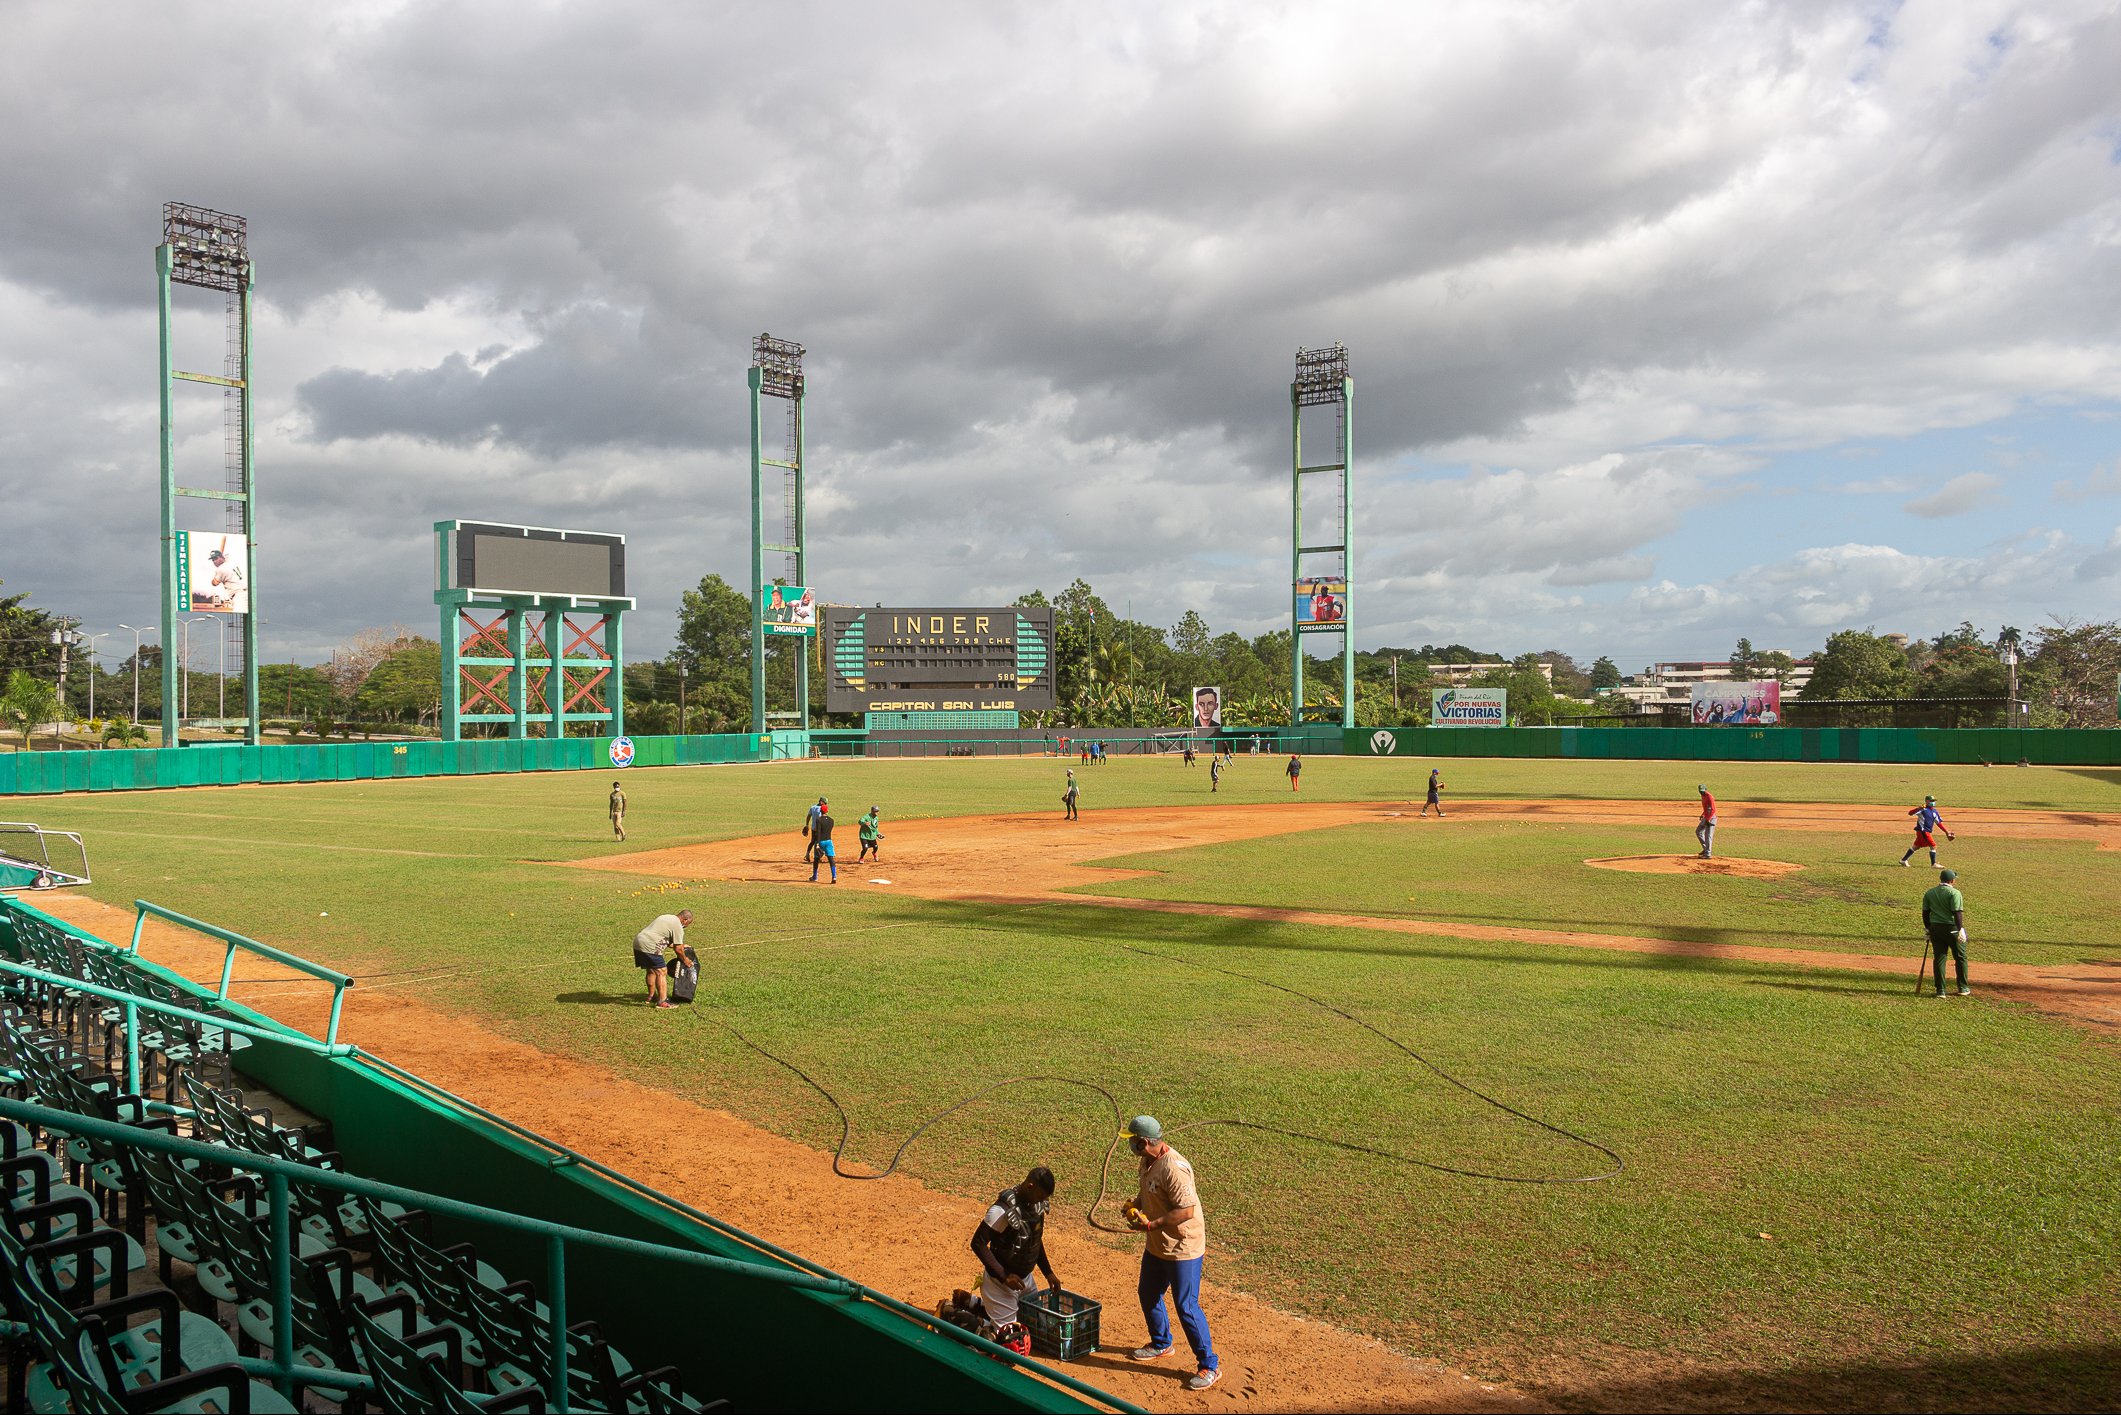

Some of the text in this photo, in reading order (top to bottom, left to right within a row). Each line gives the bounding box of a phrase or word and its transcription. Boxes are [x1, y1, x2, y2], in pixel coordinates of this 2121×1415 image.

[179, 533, 187, 608] EJEMPLARIDAD
[773, 625, 808, 634] DIGNIDAD
[893, 616, 989, 634] INDER
[1704, 689, 1766, 698] CAMPEONES
[869, 700, 1015, 711] CAPITAN SAN LUIS
[1436, 702, 1502, 718] VICTORIAS
[393, 746, 407, 754] 345
